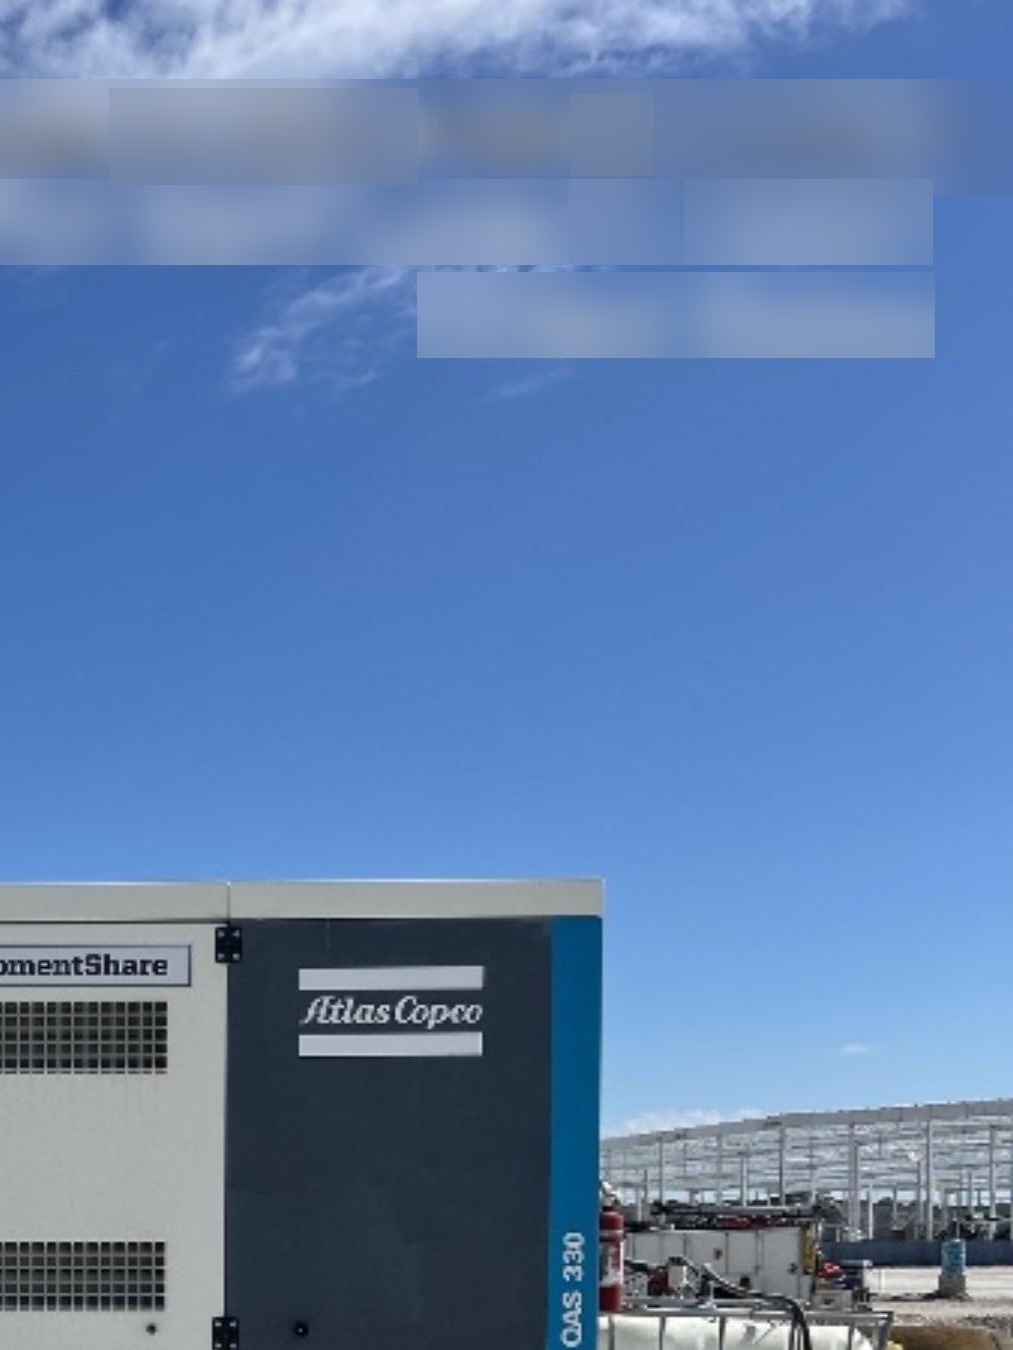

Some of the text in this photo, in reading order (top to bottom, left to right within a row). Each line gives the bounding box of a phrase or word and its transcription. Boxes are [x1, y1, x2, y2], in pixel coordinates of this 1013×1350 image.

[300, 995, 483, 1029] Atlas Copco
[561, 1231, 585, 1348] QAS 330
